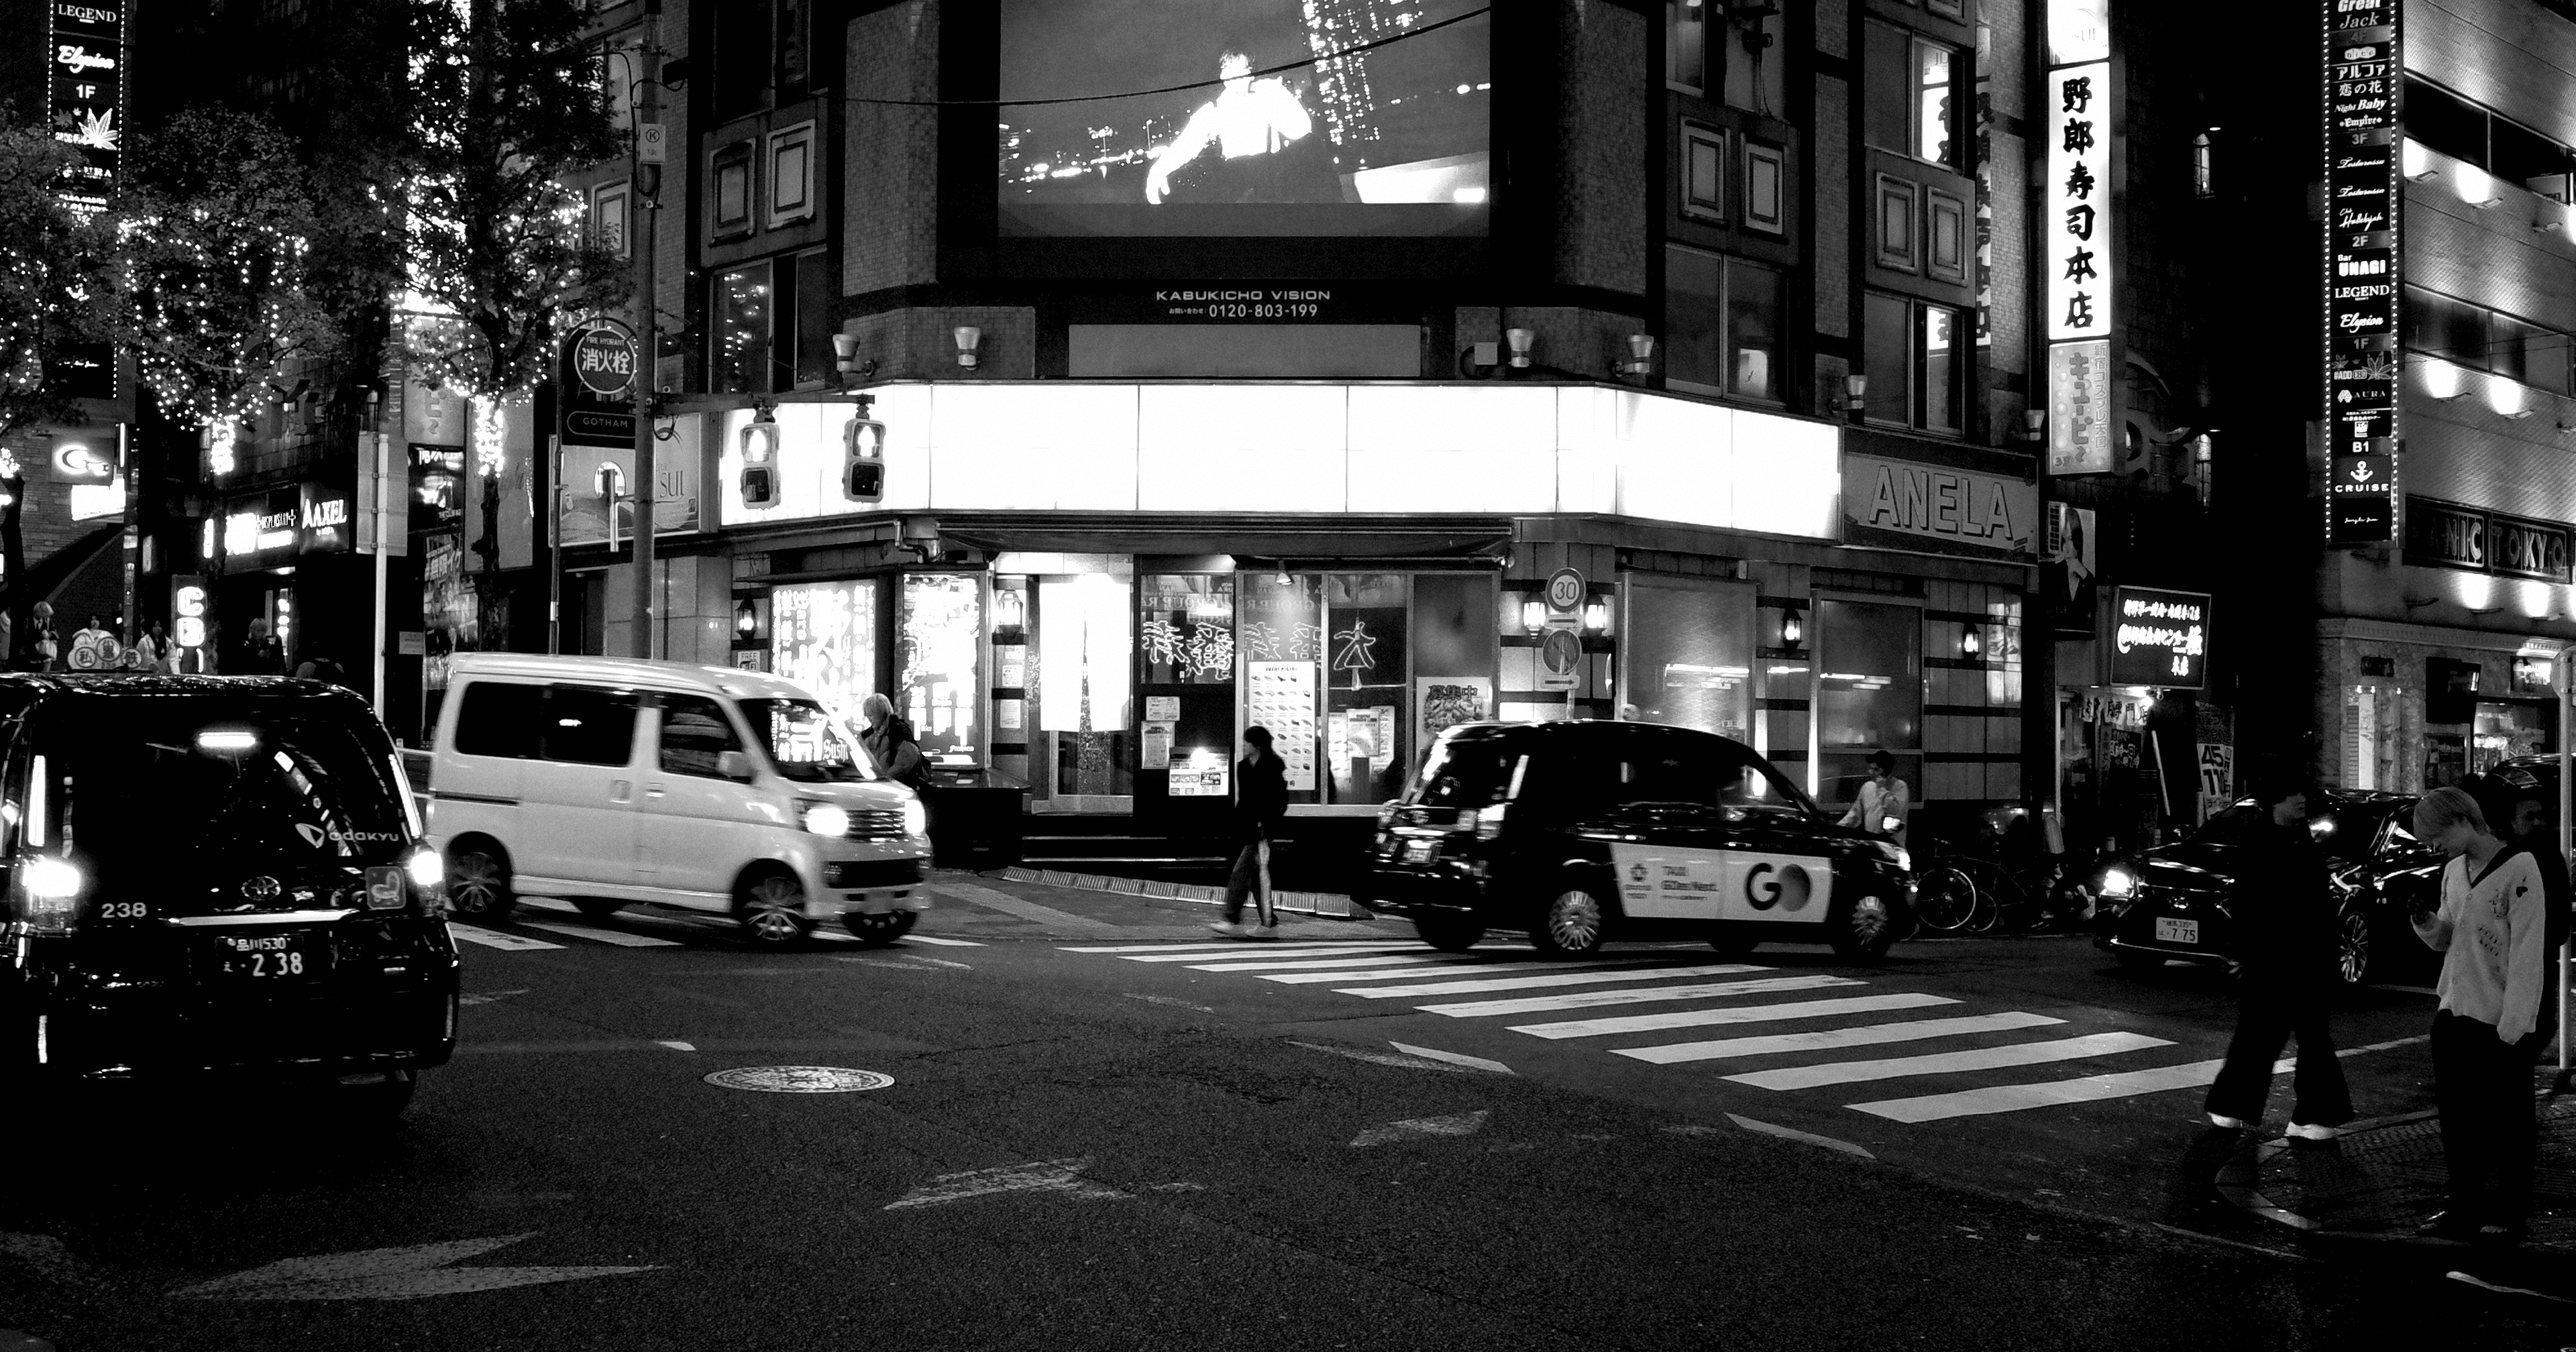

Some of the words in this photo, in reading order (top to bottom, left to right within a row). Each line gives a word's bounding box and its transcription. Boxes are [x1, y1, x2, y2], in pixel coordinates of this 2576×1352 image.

[58, 3, 117, 22] LEGEND
[2339, 11, 2380, 30] Jack
[2337, 64, 2385, 80] アルファ
[76, 84, 96, 99] 1F
[2339, 80, 2383, 97] 恋の花
[2334, 103, 2357, 113] Night
[2357, 98, 2387, 111] Baby
[2352, 133, 2368, 145] 3F
[2063, 76, 2098, 329] 野郎寿司本店
[2352, 235, 2369, 247] 2F
[2339, 260, 2385, 277] UNAGI
[1157, 290, 1263, 300] KABUKICHO
[1271, 290, 1330, 300] VISION
[2334, 285, 2390, 298] LEGEND
[1209, 304, 1318, 317] 0120-803-199
[2340, 313, 2384, 333] Elysion
[586, 336, 598, 344] FIRE
[600, 338, 625, 346] HYDRANT
[2353, 338, 2369, 349] 1F
[582, 347, 631, 374] 消火栓
[2353, 390, 2385, 398] AURA
[583, 417, 628, 428] GOTHAM
[2353, 441, 2369, 453] B1
[2334, 484, 2389, 492] CRUISE
[1868, 465, 2014, 541] ANELA
[1555, 581, 1576, 600] 30
[741, 652, 757, 661] FREE
[101, 902, 147, 918] 238
